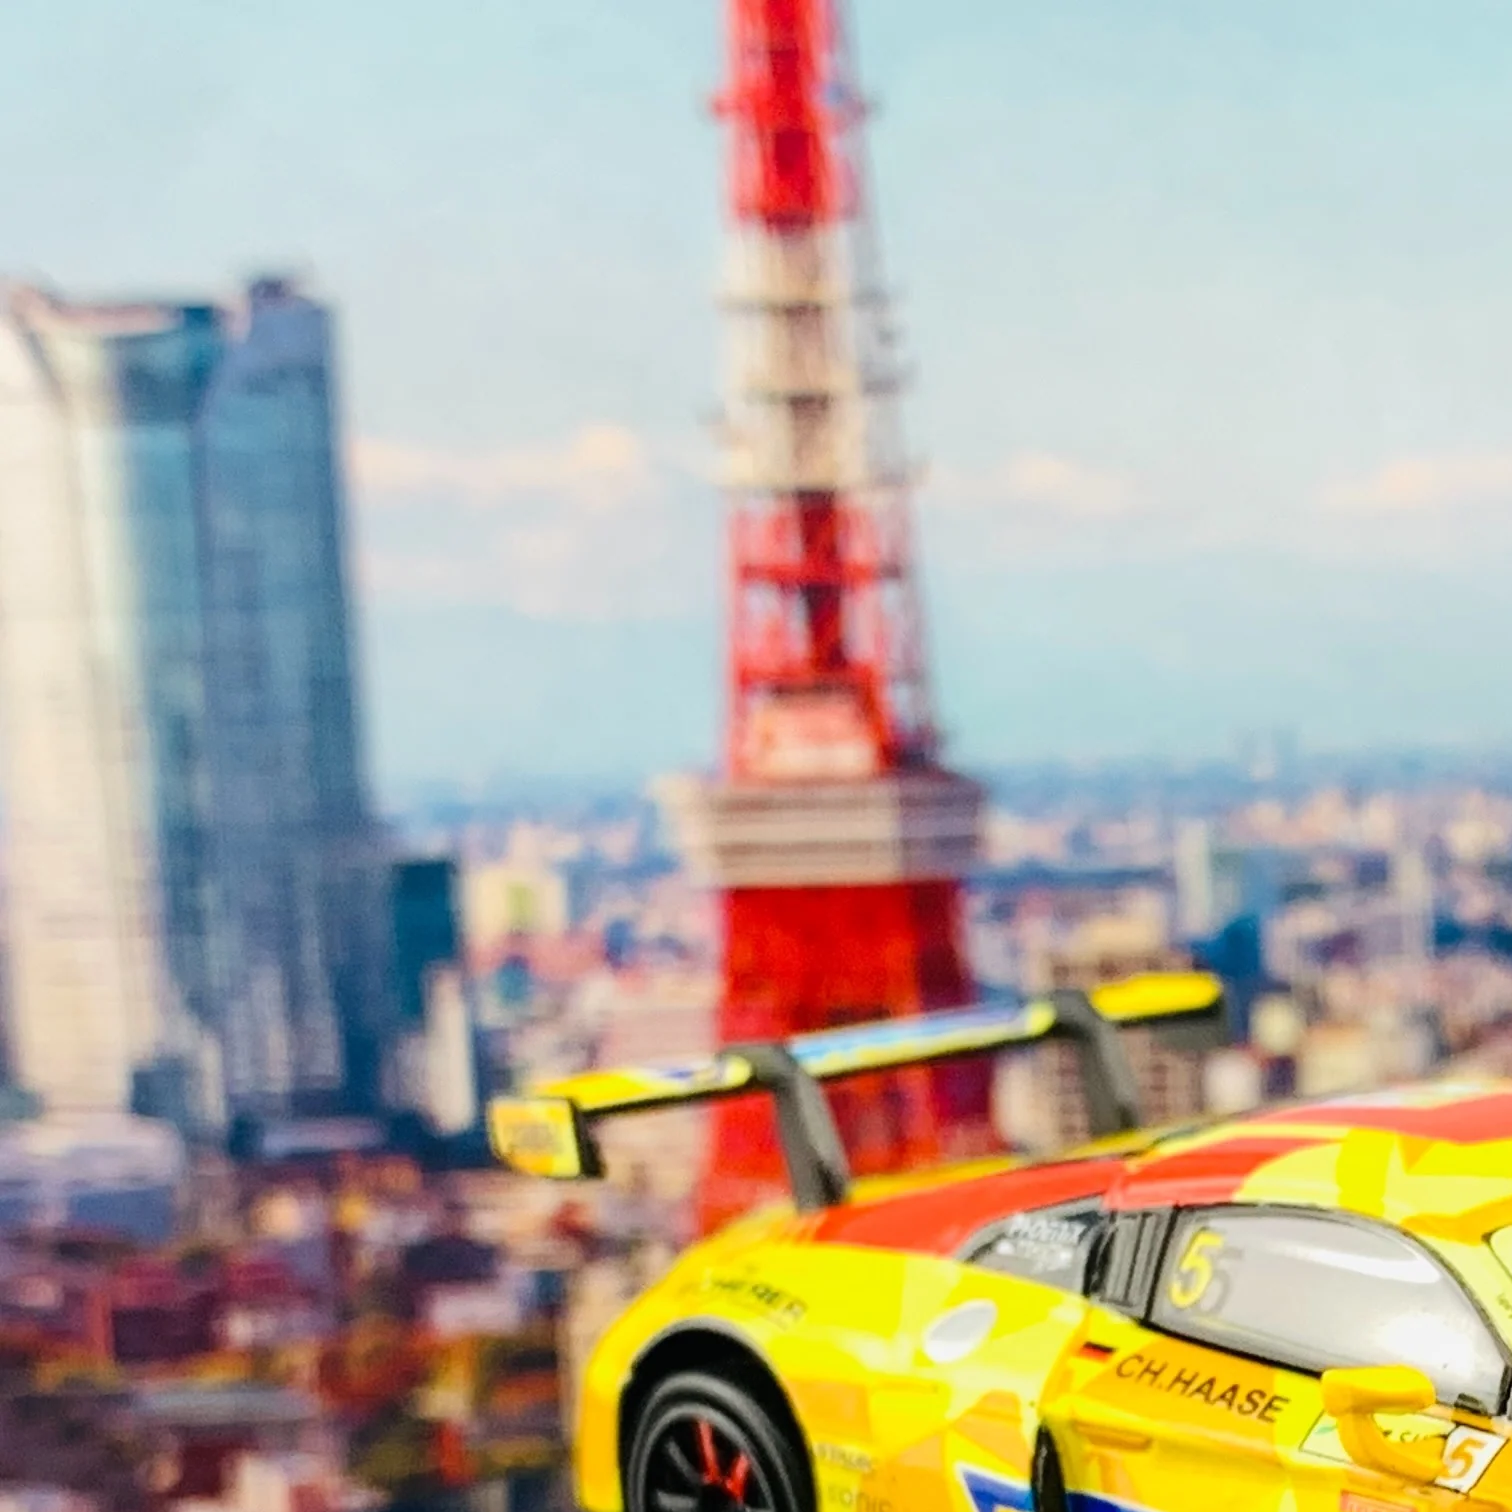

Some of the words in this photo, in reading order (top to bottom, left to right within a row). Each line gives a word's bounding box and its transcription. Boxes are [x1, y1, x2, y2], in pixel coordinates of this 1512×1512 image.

[1168, 1228, 1223, 1308] 5
[1115, 1353, 1290, 1424] CH.HAASE
[1441, 1437, 1487, 1480] 5
